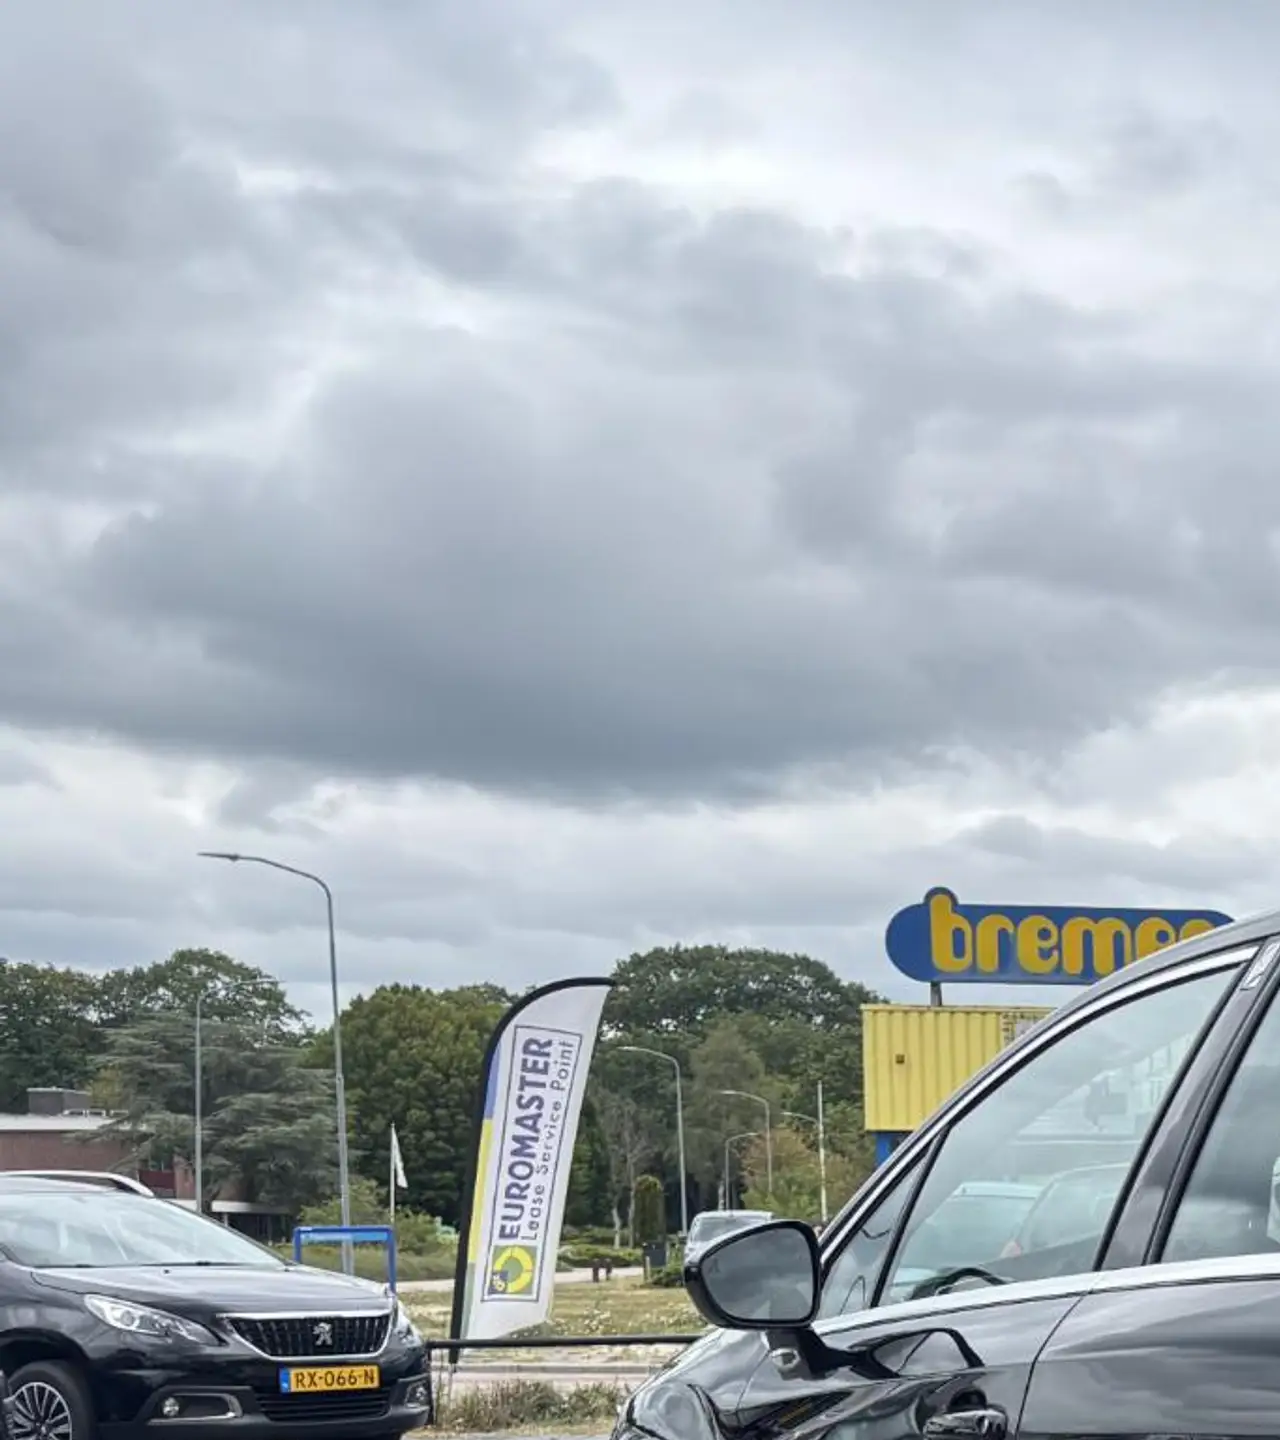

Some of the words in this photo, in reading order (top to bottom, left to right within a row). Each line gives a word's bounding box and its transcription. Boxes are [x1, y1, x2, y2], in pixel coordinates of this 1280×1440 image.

[499, 1035, 553, 1241] EUROMASTER
[520, 1184, 546, 1241] Lease
[535, 1096, 563, 1176] Service
[551, 1037, 576, 1093] Point
[295, 1369, 375, 1389] RX-066-N
